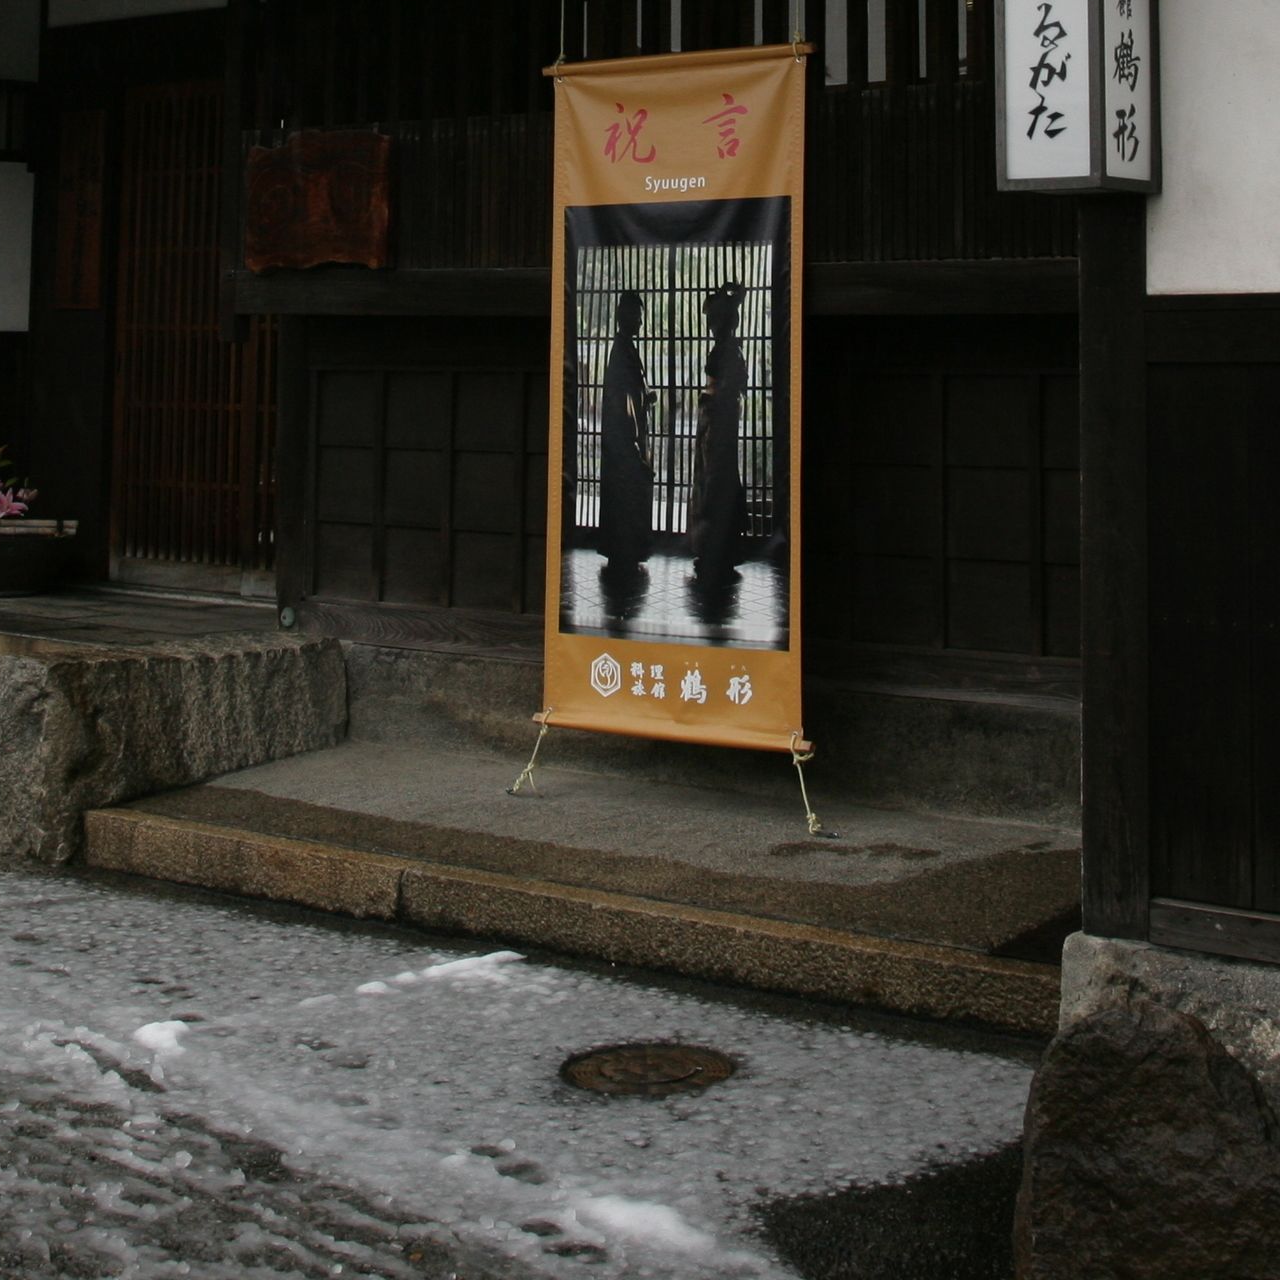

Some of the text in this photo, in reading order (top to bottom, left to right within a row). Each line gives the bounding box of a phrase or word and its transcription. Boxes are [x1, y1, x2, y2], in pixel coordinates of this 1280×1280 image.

[603, 93, 748, 164] 祝言
[645, 175, 706, 193] Syuugen
[630, 661, 664, 680] 料理
[631, 680, 665, 699] 旅館
[679, 669, 753, 705] 鶴形
